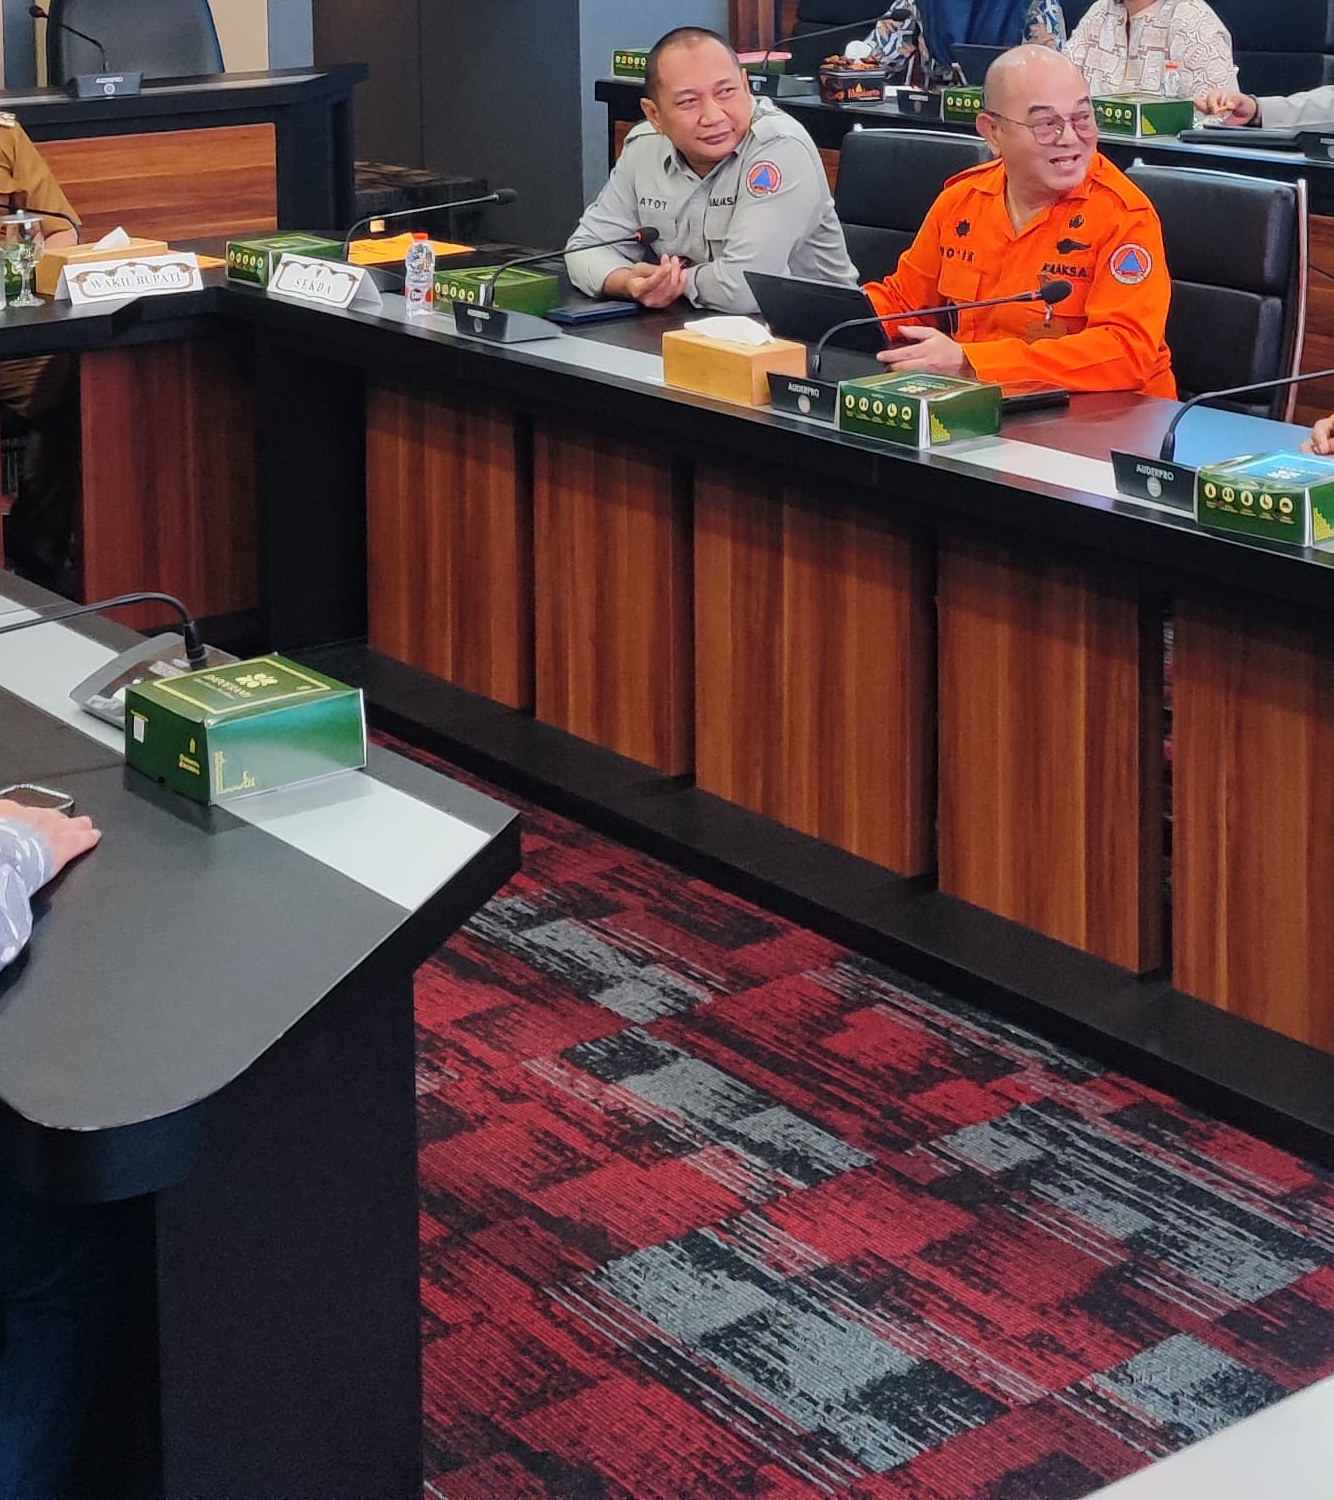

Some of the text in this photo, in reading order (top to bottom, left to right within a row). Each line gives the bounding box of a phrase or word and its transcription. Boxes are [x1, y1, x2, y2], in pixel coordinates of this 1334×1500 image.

[90, 271, 182, 290] WAKIL BUPATI
[295, 278, 332, 296] SEKDA
